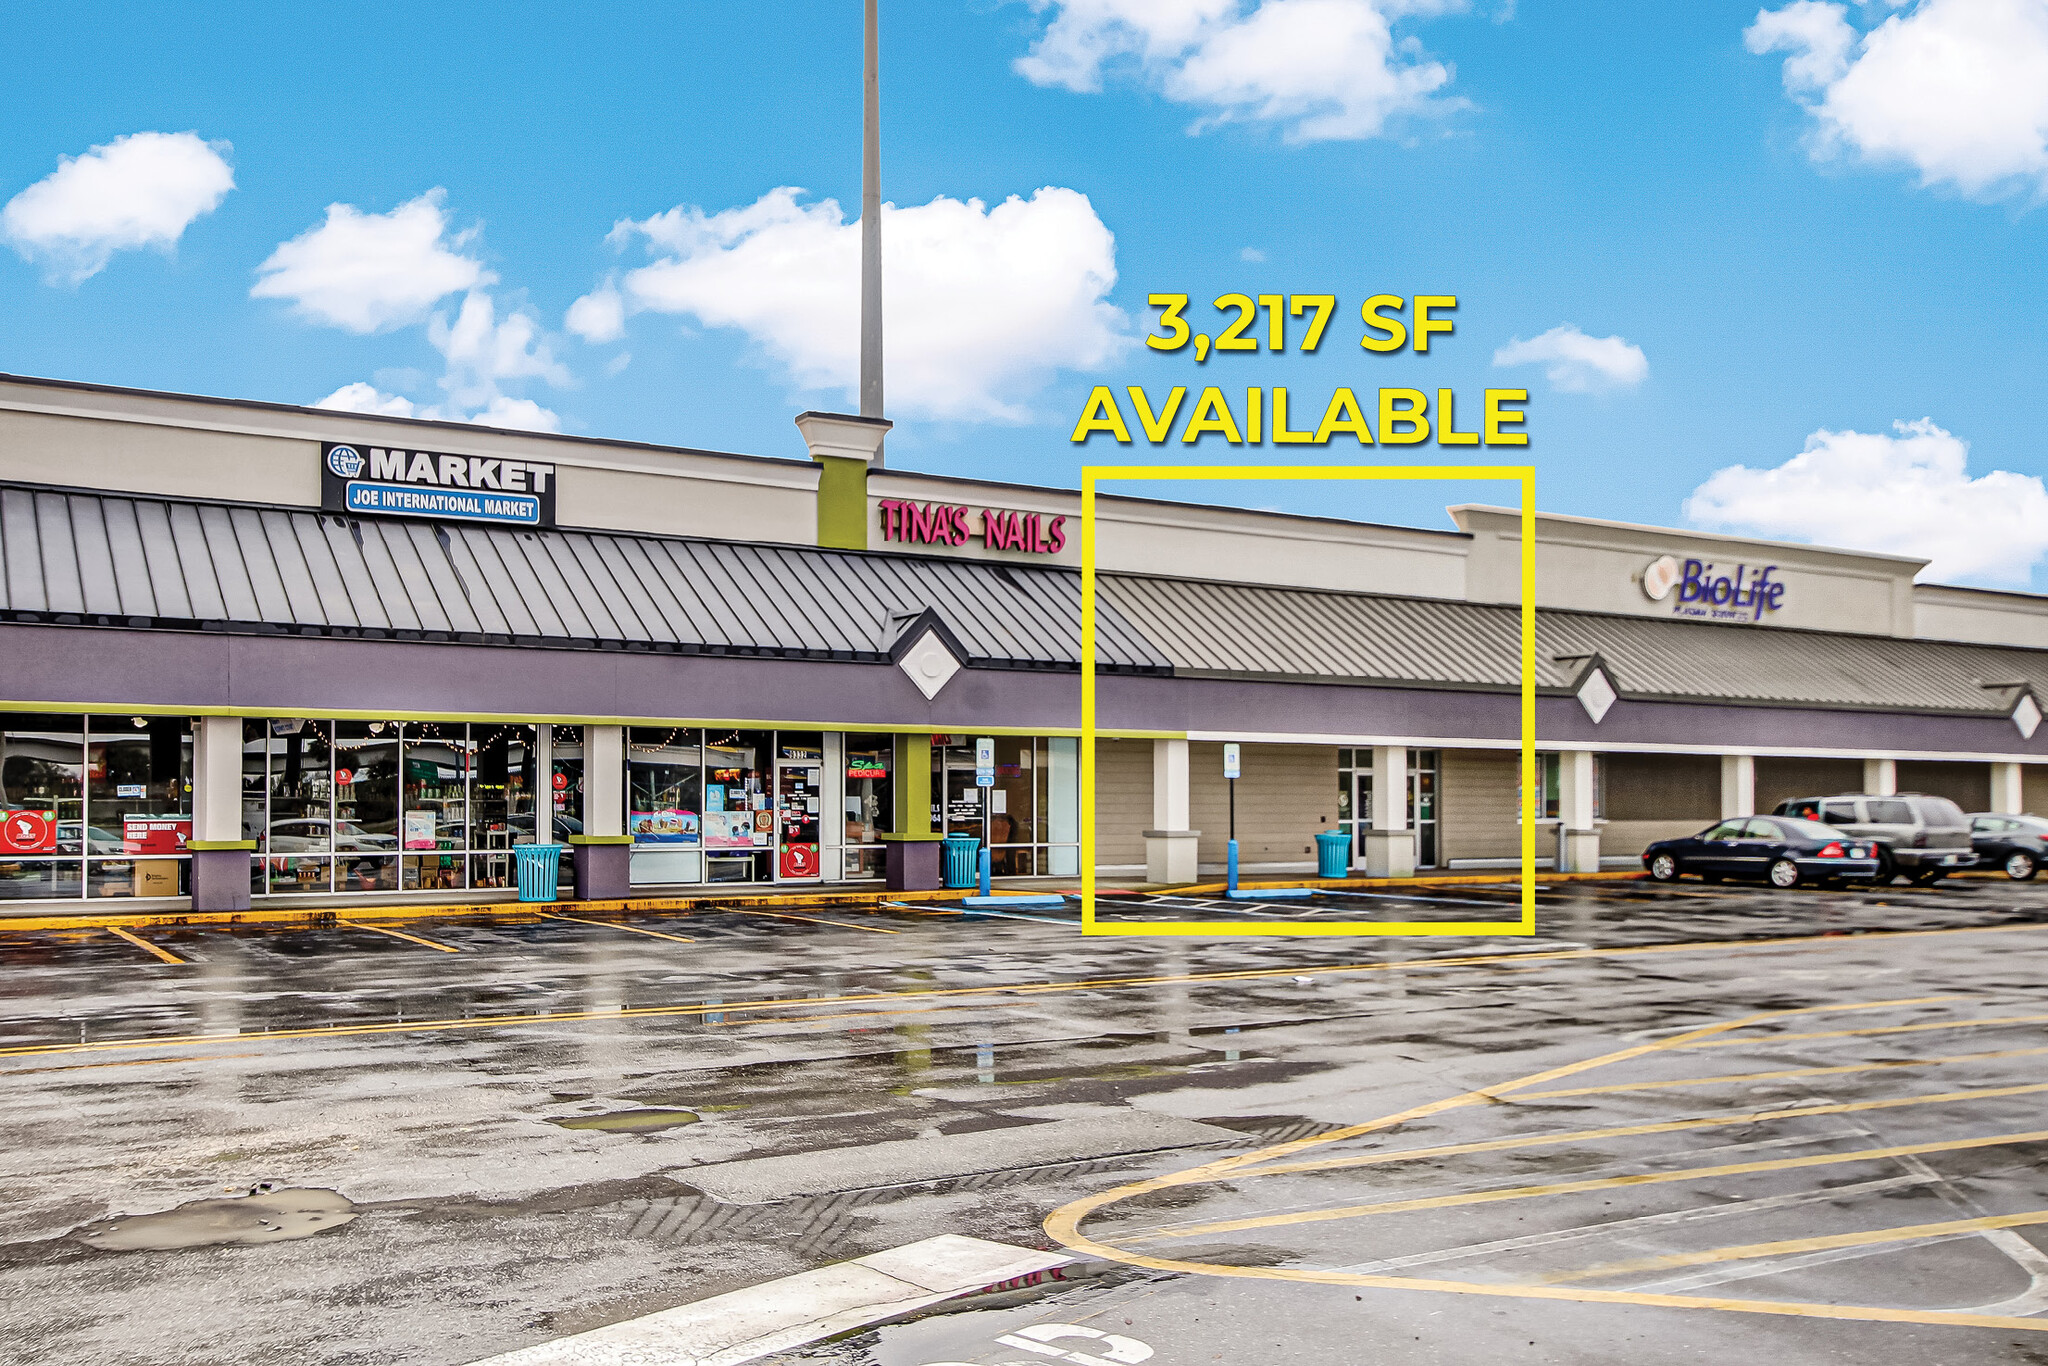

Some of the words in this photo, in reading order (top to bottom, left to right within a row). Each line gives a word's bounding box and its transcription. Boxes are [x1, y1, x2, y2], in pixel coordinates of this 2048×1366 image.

[369, 448, 554, 493] MARKET
[353, 489, 379, 505] JOE
[382, 490, 481, 514] INTERNATIONAL
[484, 499, 534, 517] MARKET
[878, 499, 971, 547] TINA'S
[981, 508, 1066, 553] NAILS
[1679, 559, 1784, 621] BioLife
[848, 769, 886, 778] PEDICURE
[849, 760, 884, 770] Spa
[126, 823, 148, 832] SEND
[149, 822, 178, 831] MONEY
